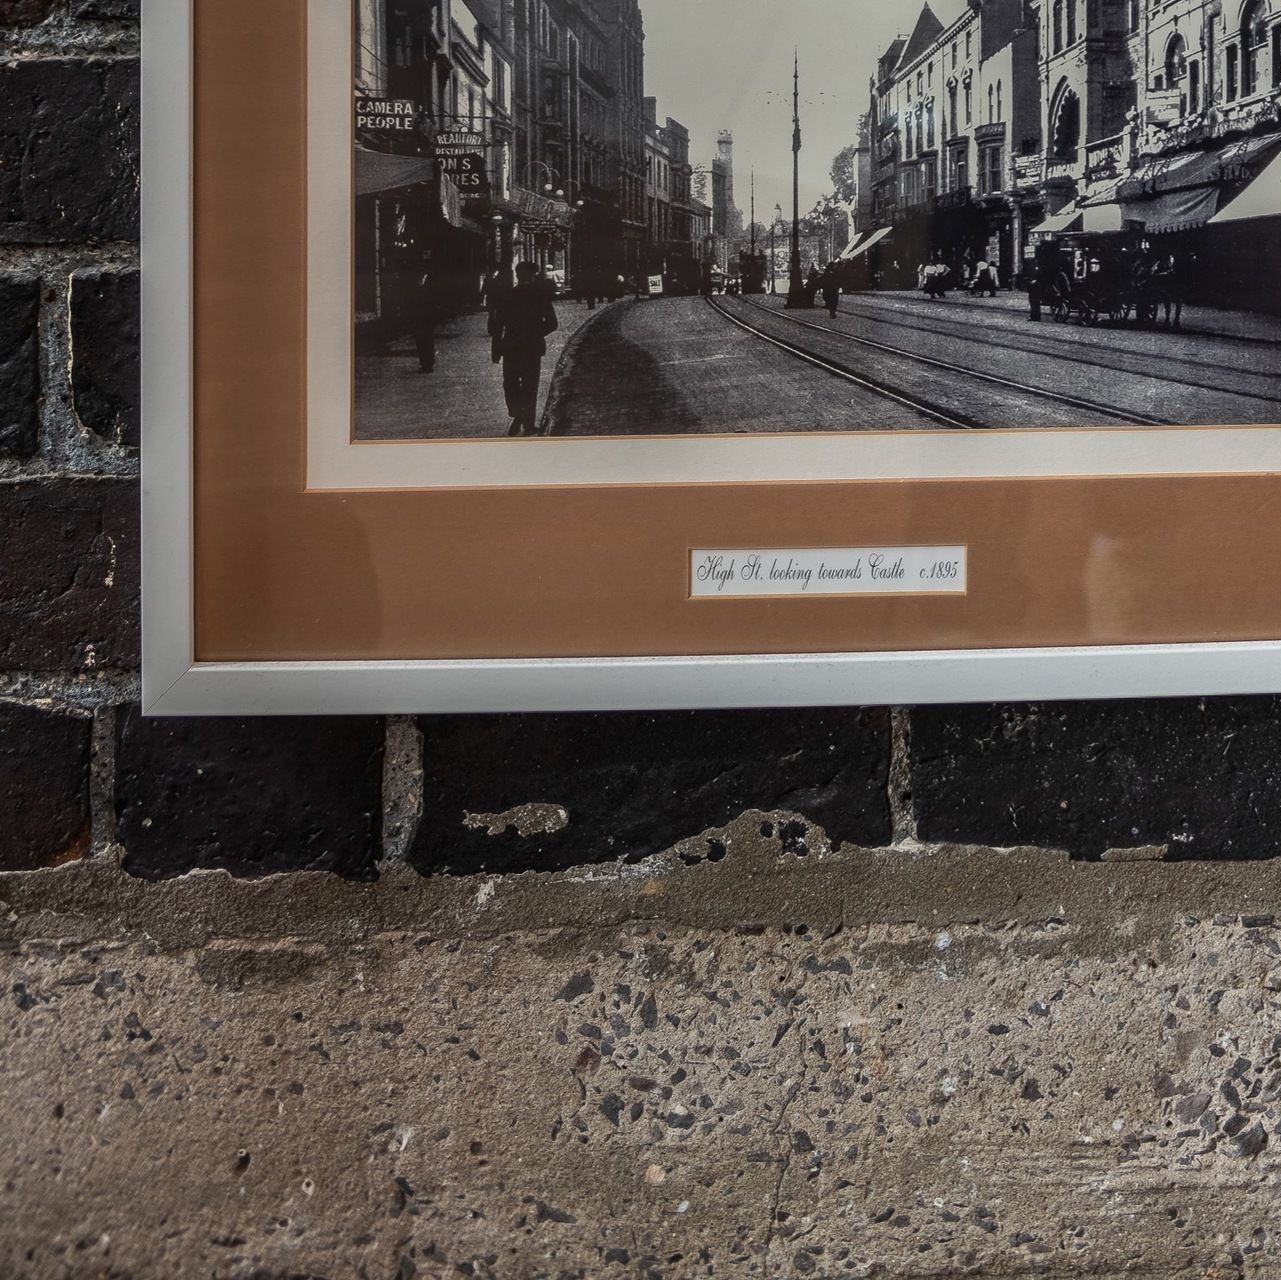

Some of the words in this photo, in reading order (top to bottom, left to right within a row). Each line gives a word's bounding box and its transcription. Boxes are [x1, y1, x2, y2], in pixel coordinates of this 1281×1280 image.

[356, 101, 413, 115] CAMERA
[357, 116, 413, 130] PEOPLE
[697, 554, 735, 591] High
[740, 553, 764, 581] St.
[769, 558, 813, 590] looking
[818, 558, 862, 580] towards
[868, 552, 906, 581] Castle
[919, 561, 960, 580] c.1895
